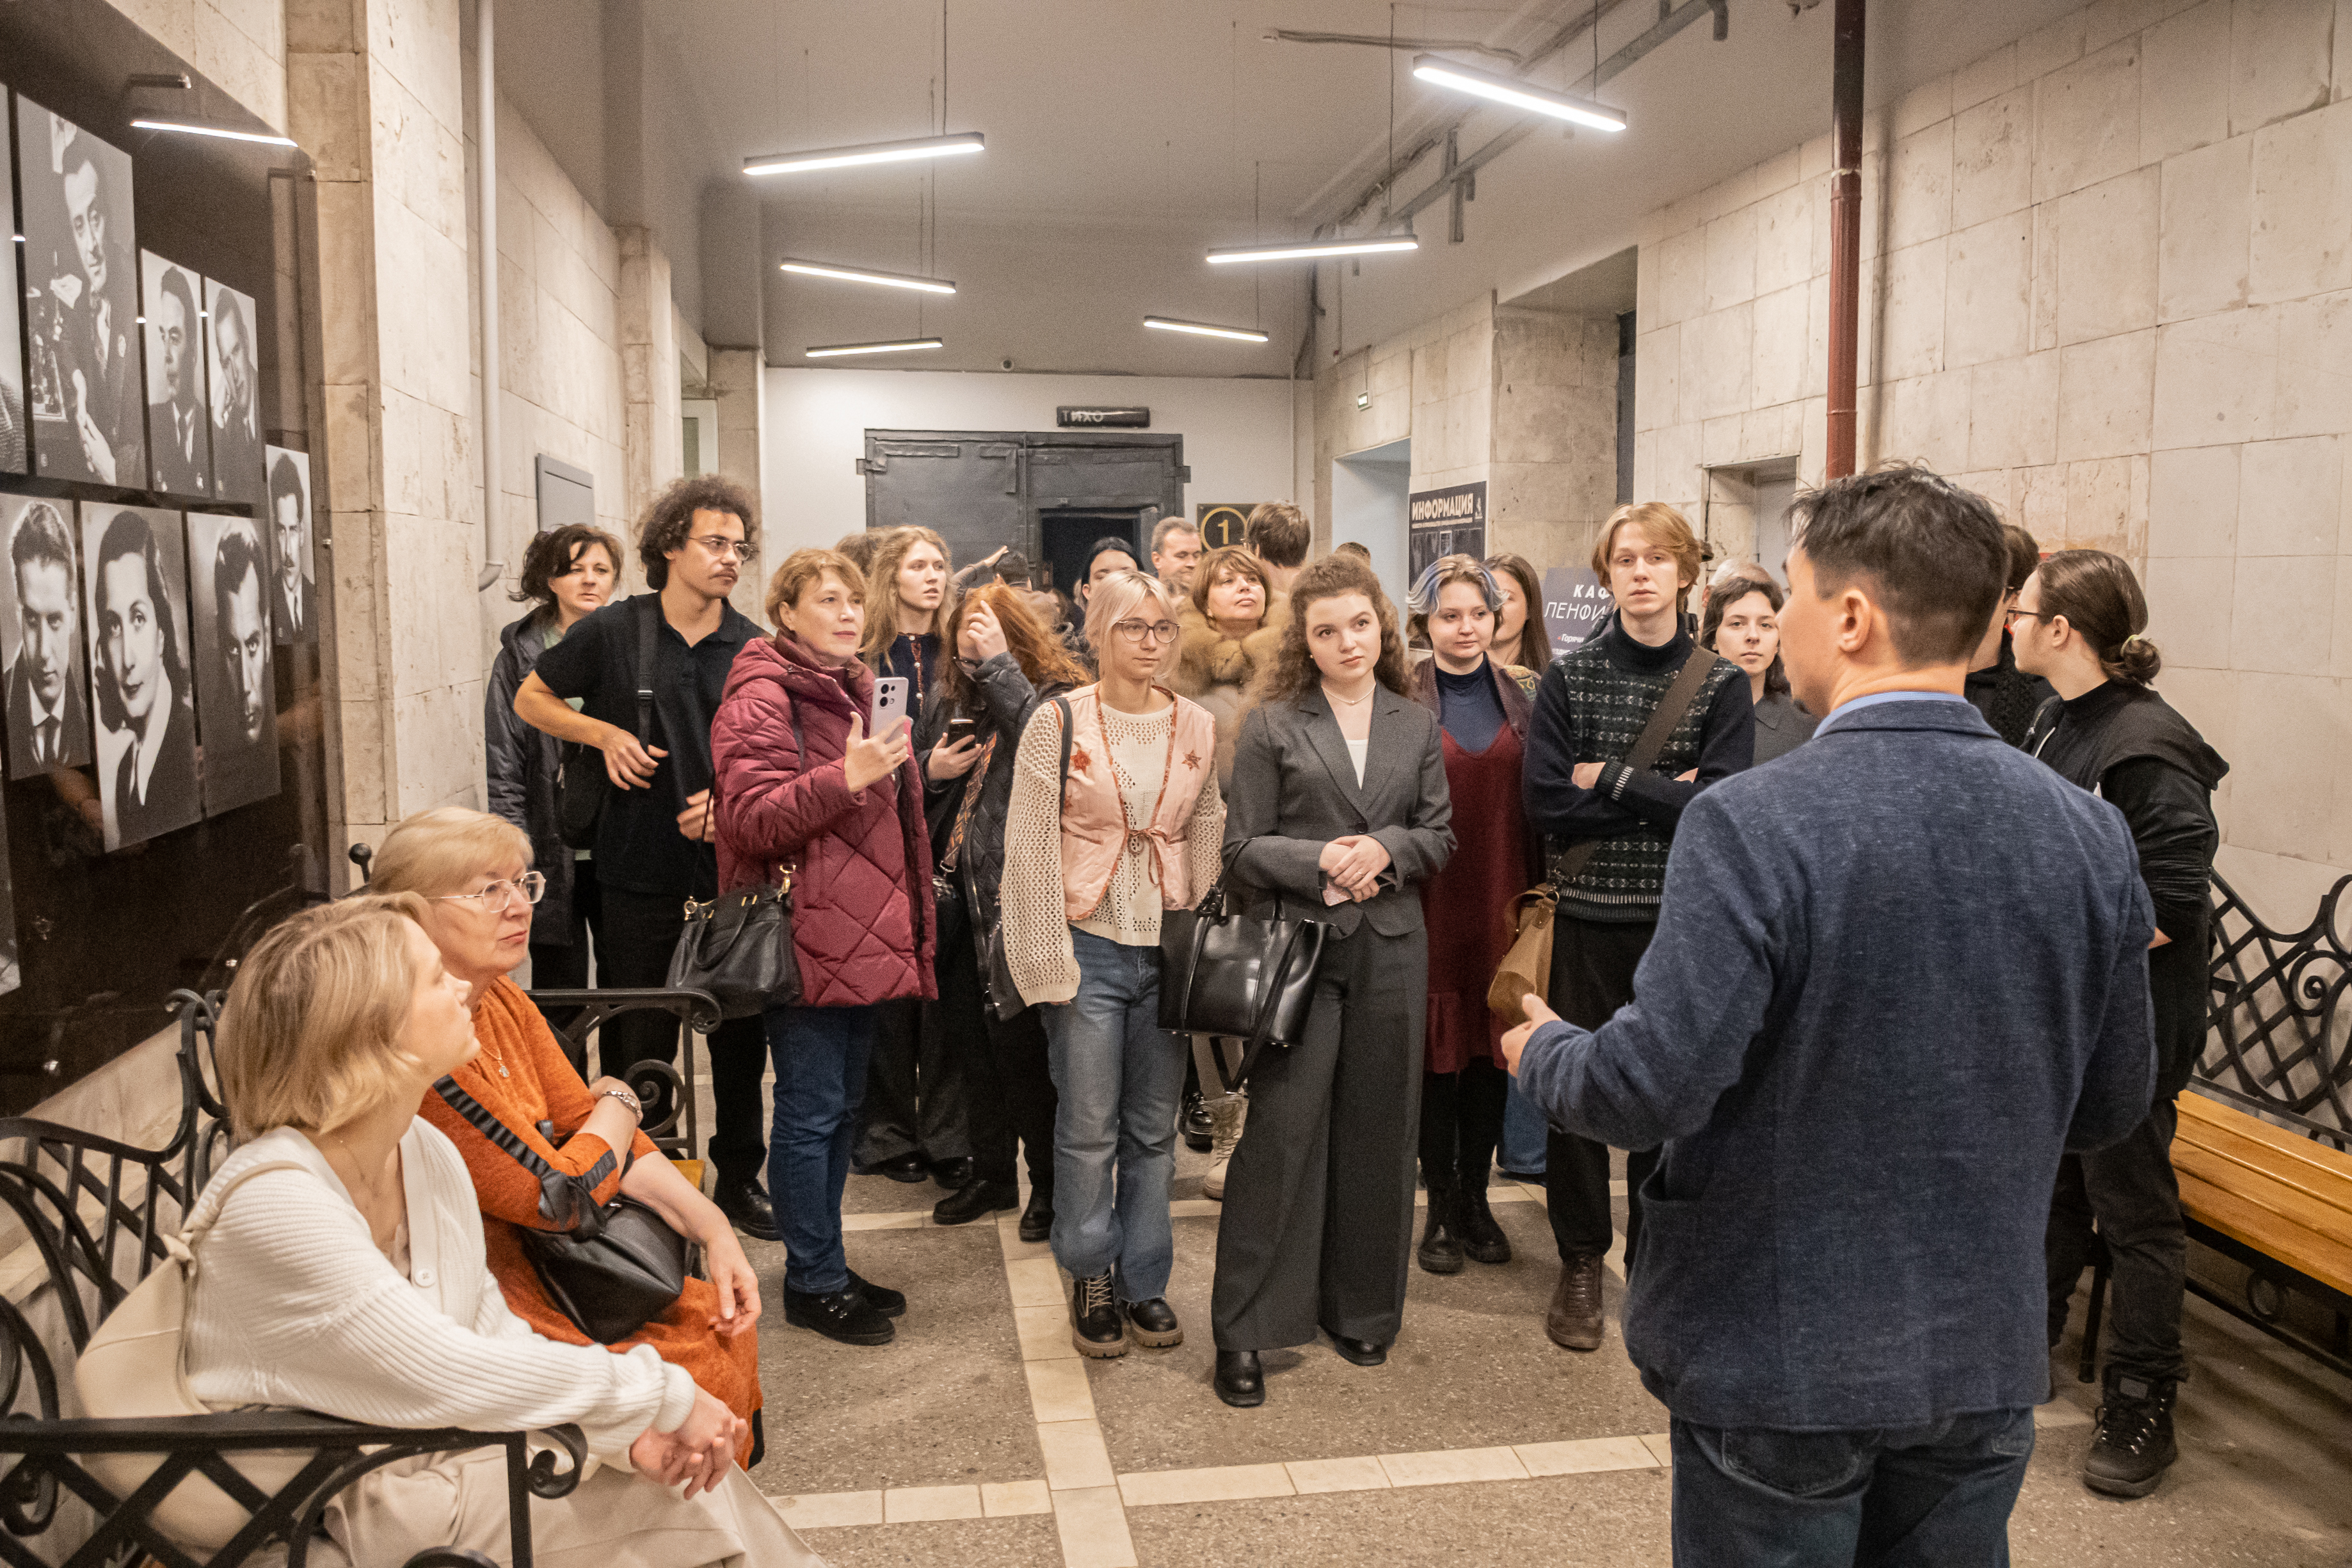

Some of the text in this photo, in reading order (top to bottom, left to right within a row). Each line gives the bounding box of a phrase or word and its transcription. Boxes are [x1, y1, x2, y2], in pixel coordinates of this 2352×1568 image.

[1062, 410, 1104, 422] ТИХО
[1411, 492, 1474, 521] ИНФОРМАЦИЯ
[1217, 519, 1229, 545] 1
[1573, 584, 1610, 600] КАФ
[1544, 602, 1606, 621] ЛЕНФИ
[1562, 634, 1585, 643] Горячи
